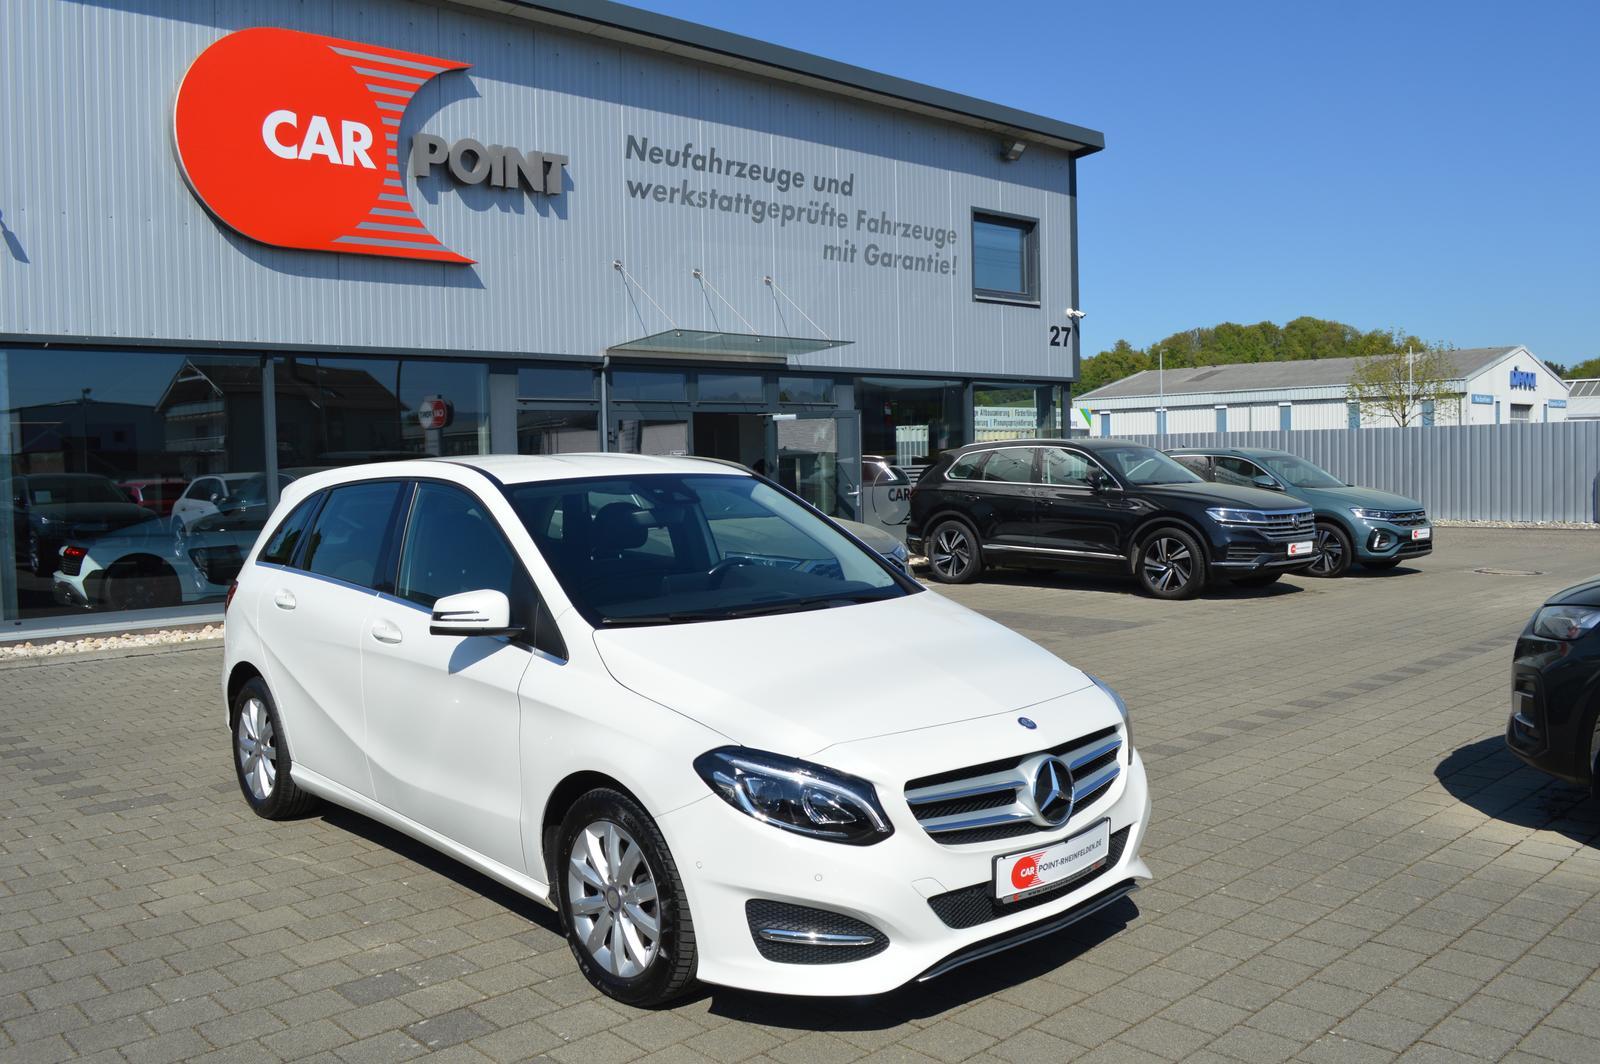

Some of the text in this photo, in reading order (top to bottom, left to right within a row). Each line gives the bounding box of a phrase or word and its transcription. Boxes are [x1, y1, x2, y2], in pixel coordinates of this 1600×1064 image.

[262, 110, 569, 195] CAR POINT
[625, 135, 854, 196] Neufahrzeuge und
[627, 179, 957, 245] werkstattgeprüfte Fahrzeuge
[823, 242, 958, 275] mit Garantie!
[1049, 326, 1071, 347] 27
[1020, 838, 1103, 878] CAR POINT-RHEINFELDEN.DE
